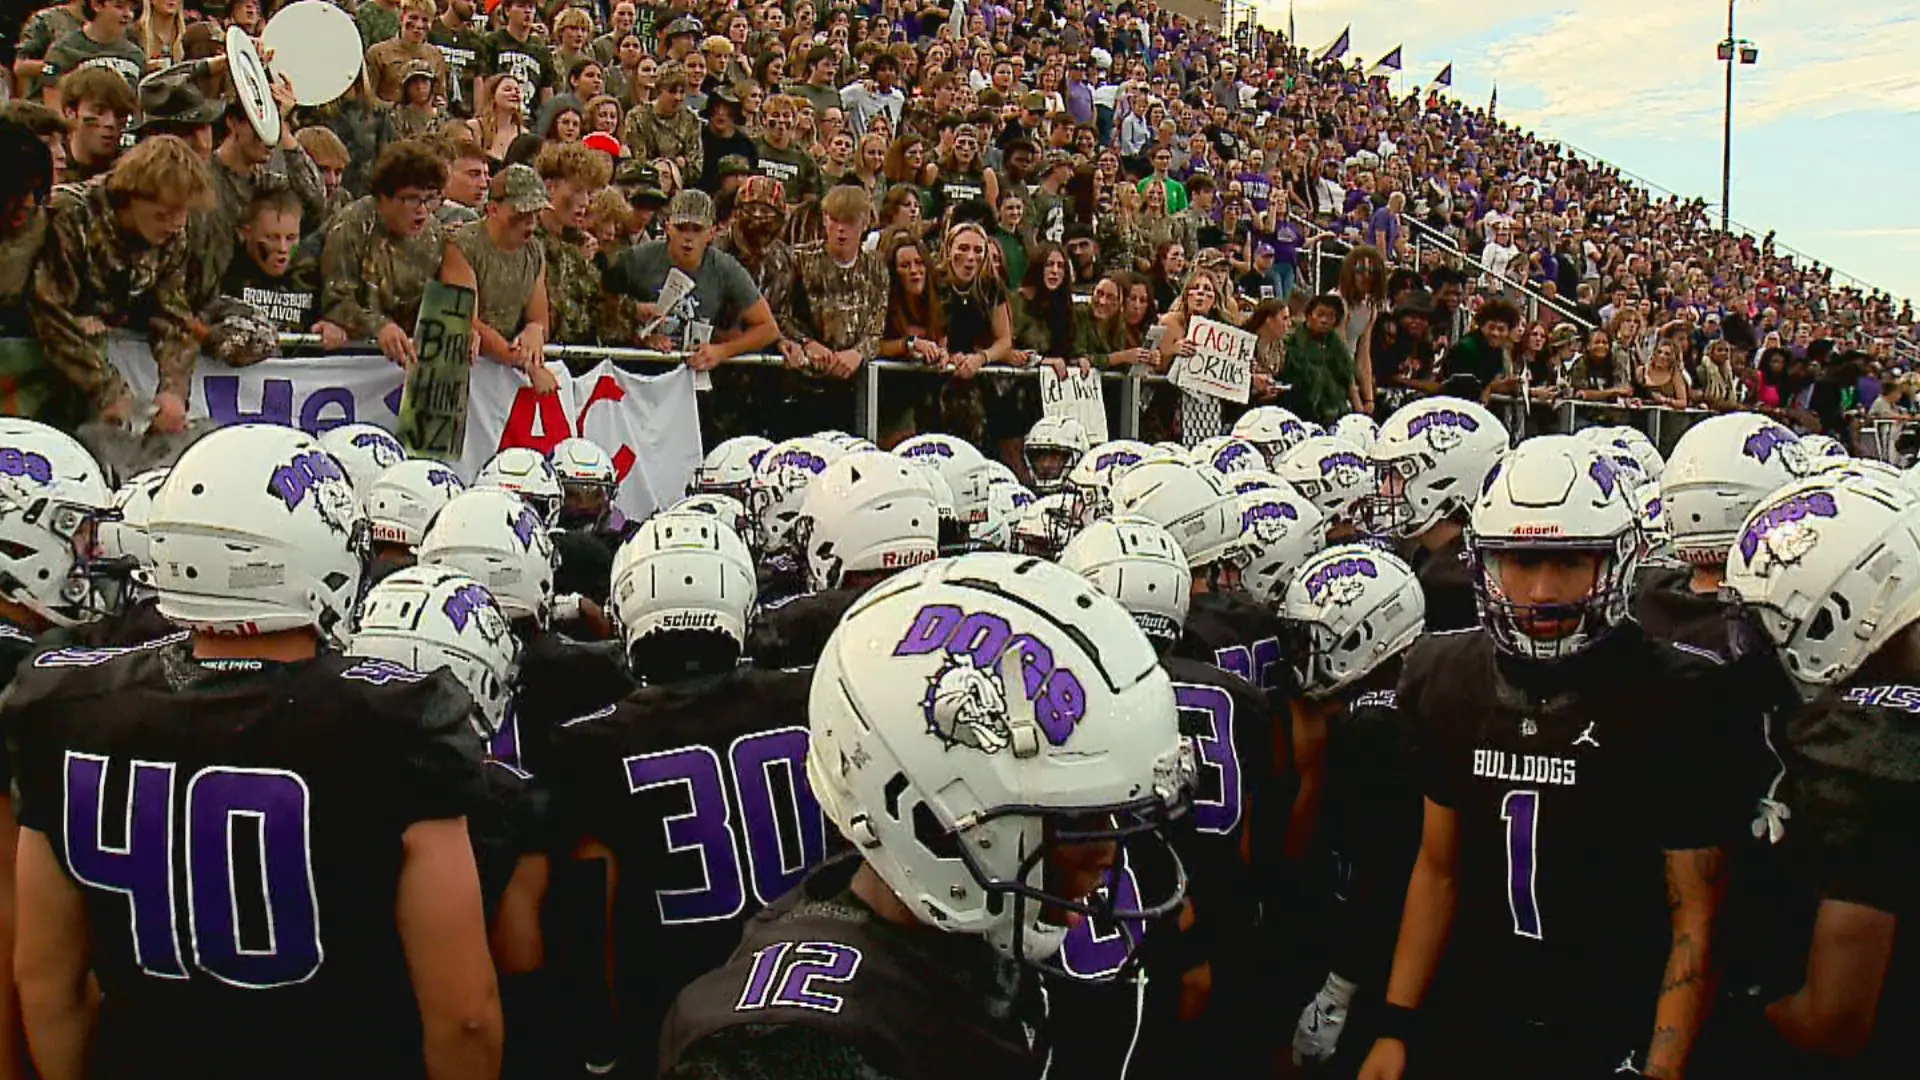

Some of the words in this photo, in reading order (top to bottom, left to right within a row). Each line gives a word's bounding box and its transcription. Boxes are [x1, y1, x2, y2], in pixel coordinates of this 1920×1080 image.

[1473, 748, 1576, 786] BULLDOGS
[63, 750, 324, 989] 40
[1502, 788, 1543, 940] 1
[734, 940, 863, 1014] 12
